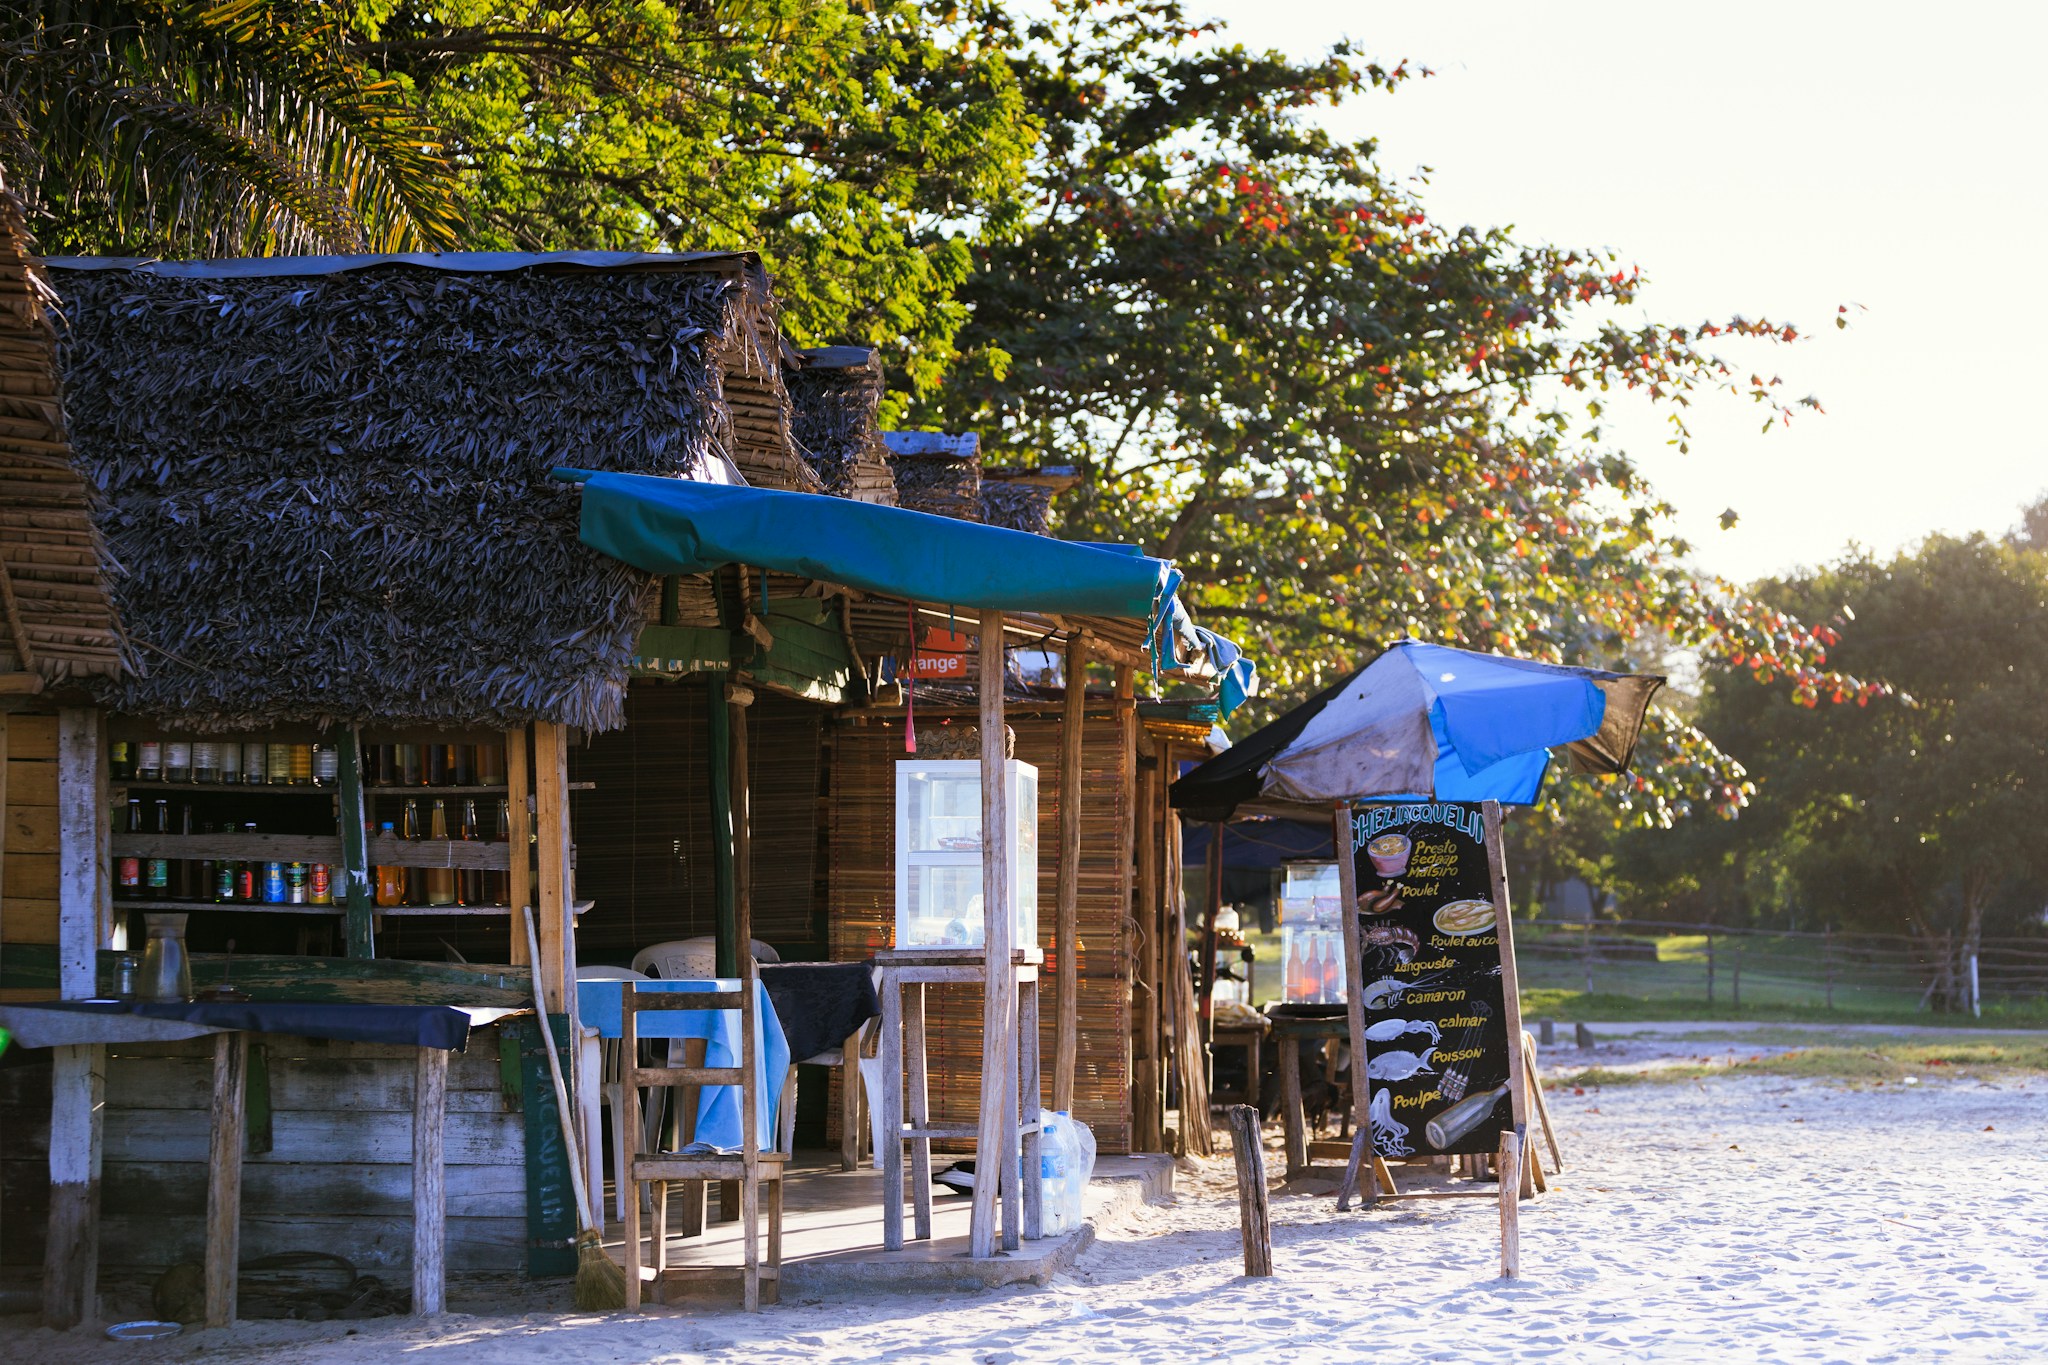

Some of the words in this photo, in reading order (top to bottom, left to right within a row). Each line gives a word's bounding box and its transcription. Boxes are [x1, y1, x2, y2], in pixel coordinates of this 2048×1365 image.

[1415, 839, 1457, 854] Presto
[1402, 882, 1440, 898] Poulet
[1431, 934, 1467, 947] Poulet
[1466, 937, 1483, 947] au
[1394, 955, 1455, 977] Langouste
[1393, 1090, 1442, 1110] Poulpe
